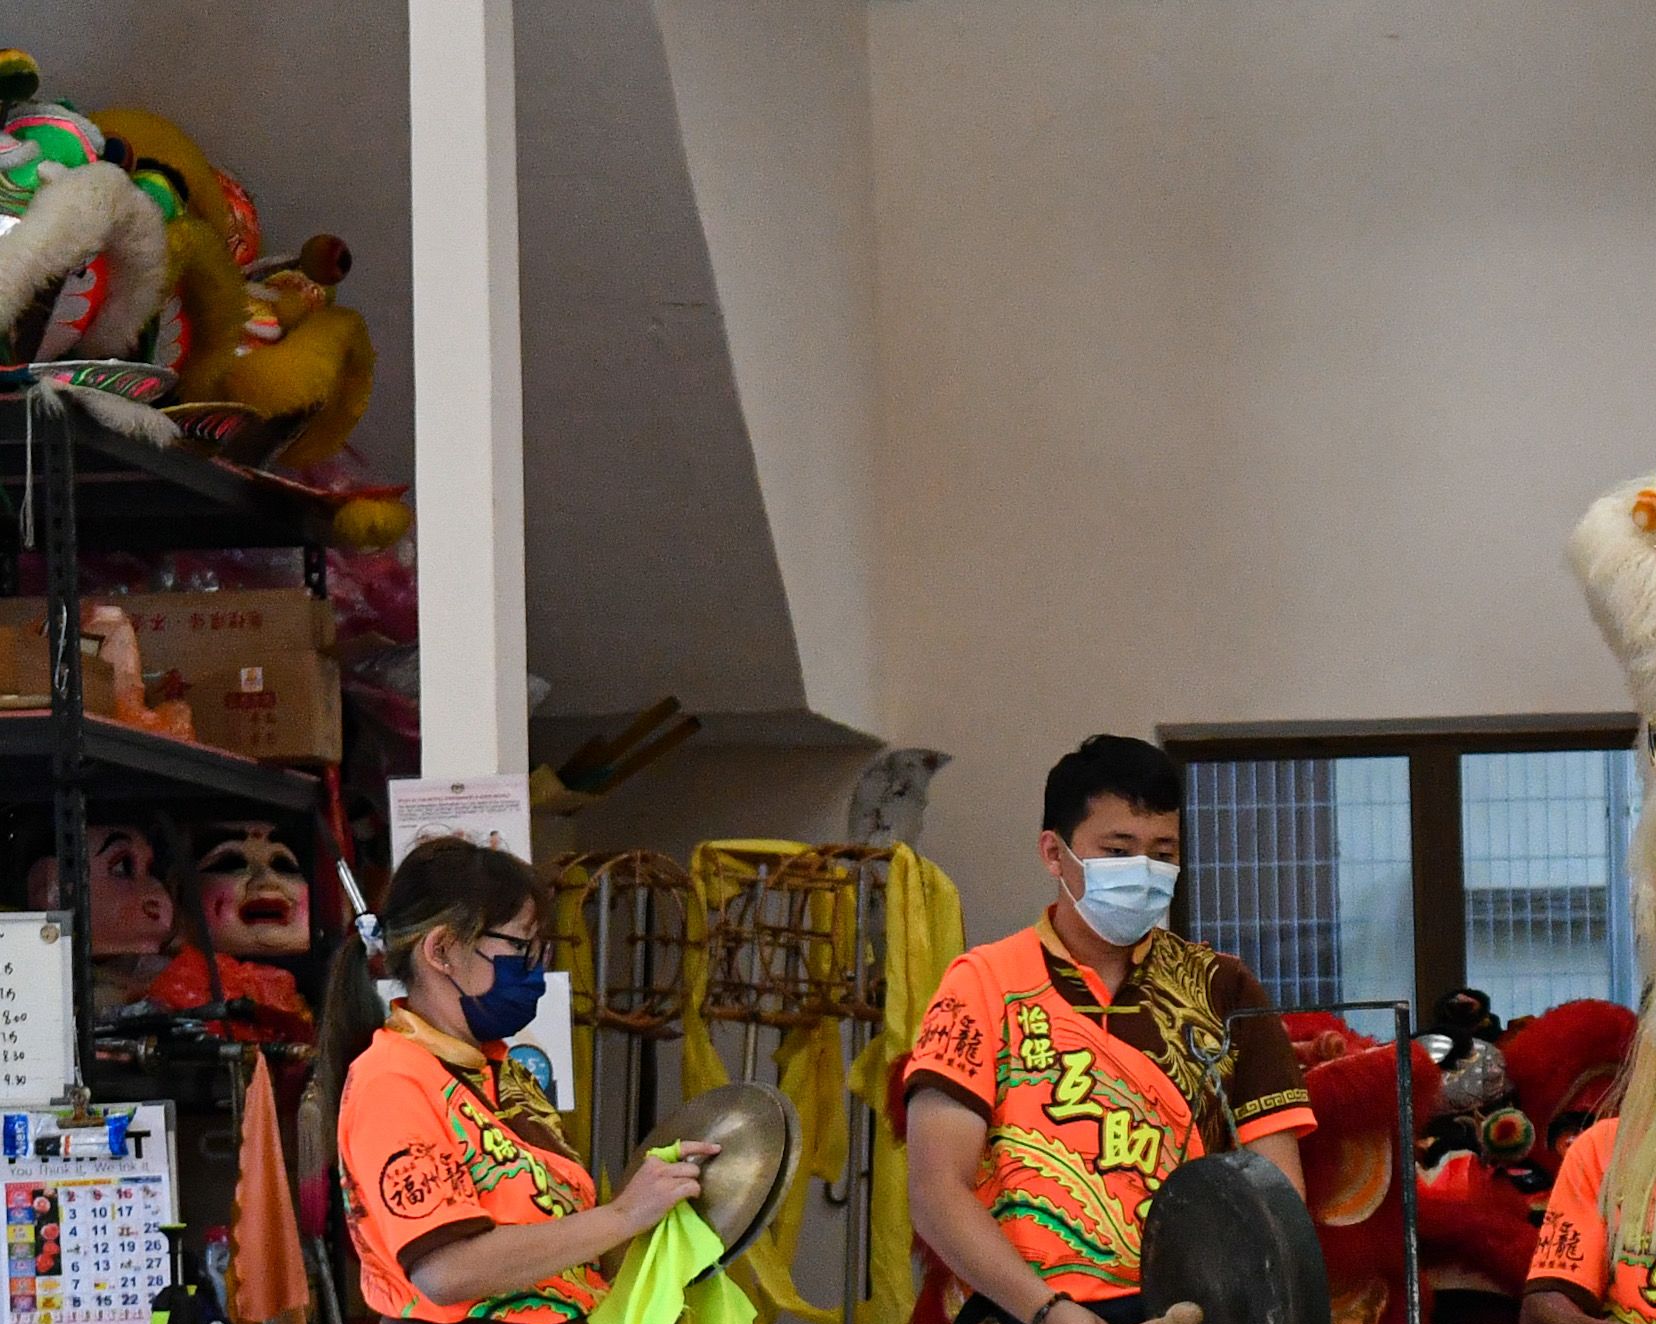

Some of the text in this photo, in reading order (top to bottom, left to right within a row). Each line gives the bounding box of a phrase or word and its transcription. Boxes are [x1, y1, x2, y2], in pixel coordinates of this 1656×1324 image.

[1017, 1004, 1057, 1070] 怡保
[1046, 1050, 1163, 1220] 互助
[10, 1165, 32, 1177] You
[69, 1205, 133, 1220] 3 10 17
[69, 1222, 160, 1237] 4 11 25
[94, 1240, 161, 1254] 12 19 26
[71, 1258, 162, 1273] 6 13 27
[73, 1275, 164, 1290] 7 21 28
[97, 1295, 112, 1307] 15
[122, 1293, 138, 1306] 22
